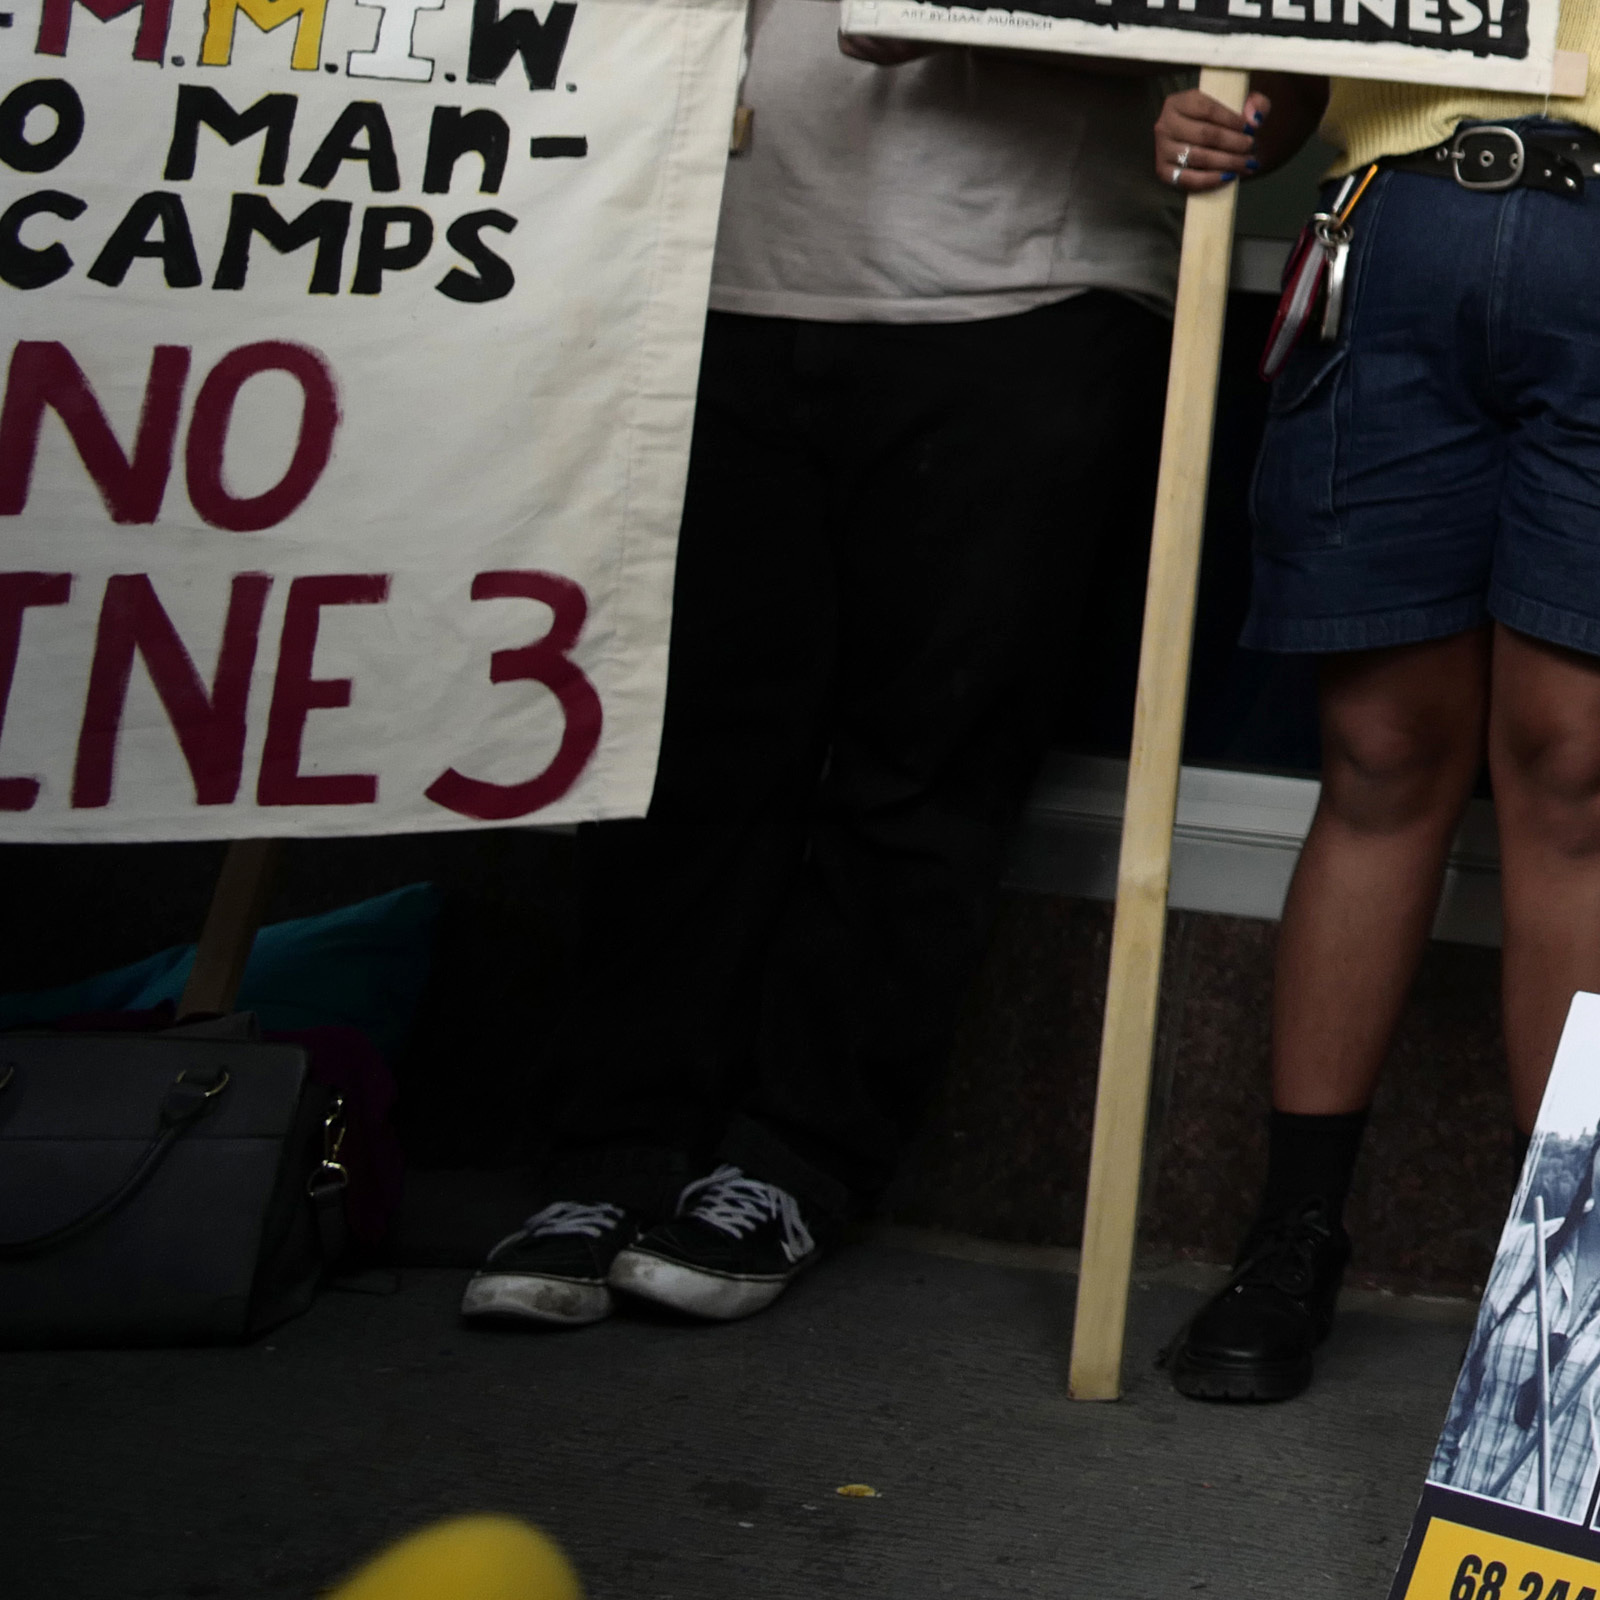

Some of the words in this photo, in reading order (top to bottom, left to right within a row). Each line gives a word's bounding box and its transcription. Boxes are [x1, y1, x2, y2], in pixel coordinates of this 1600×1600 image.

[0, 189, 518, 304] CAMPS
[0, 339, 343, 532] NO
[424, 569, 603, 819] 3
